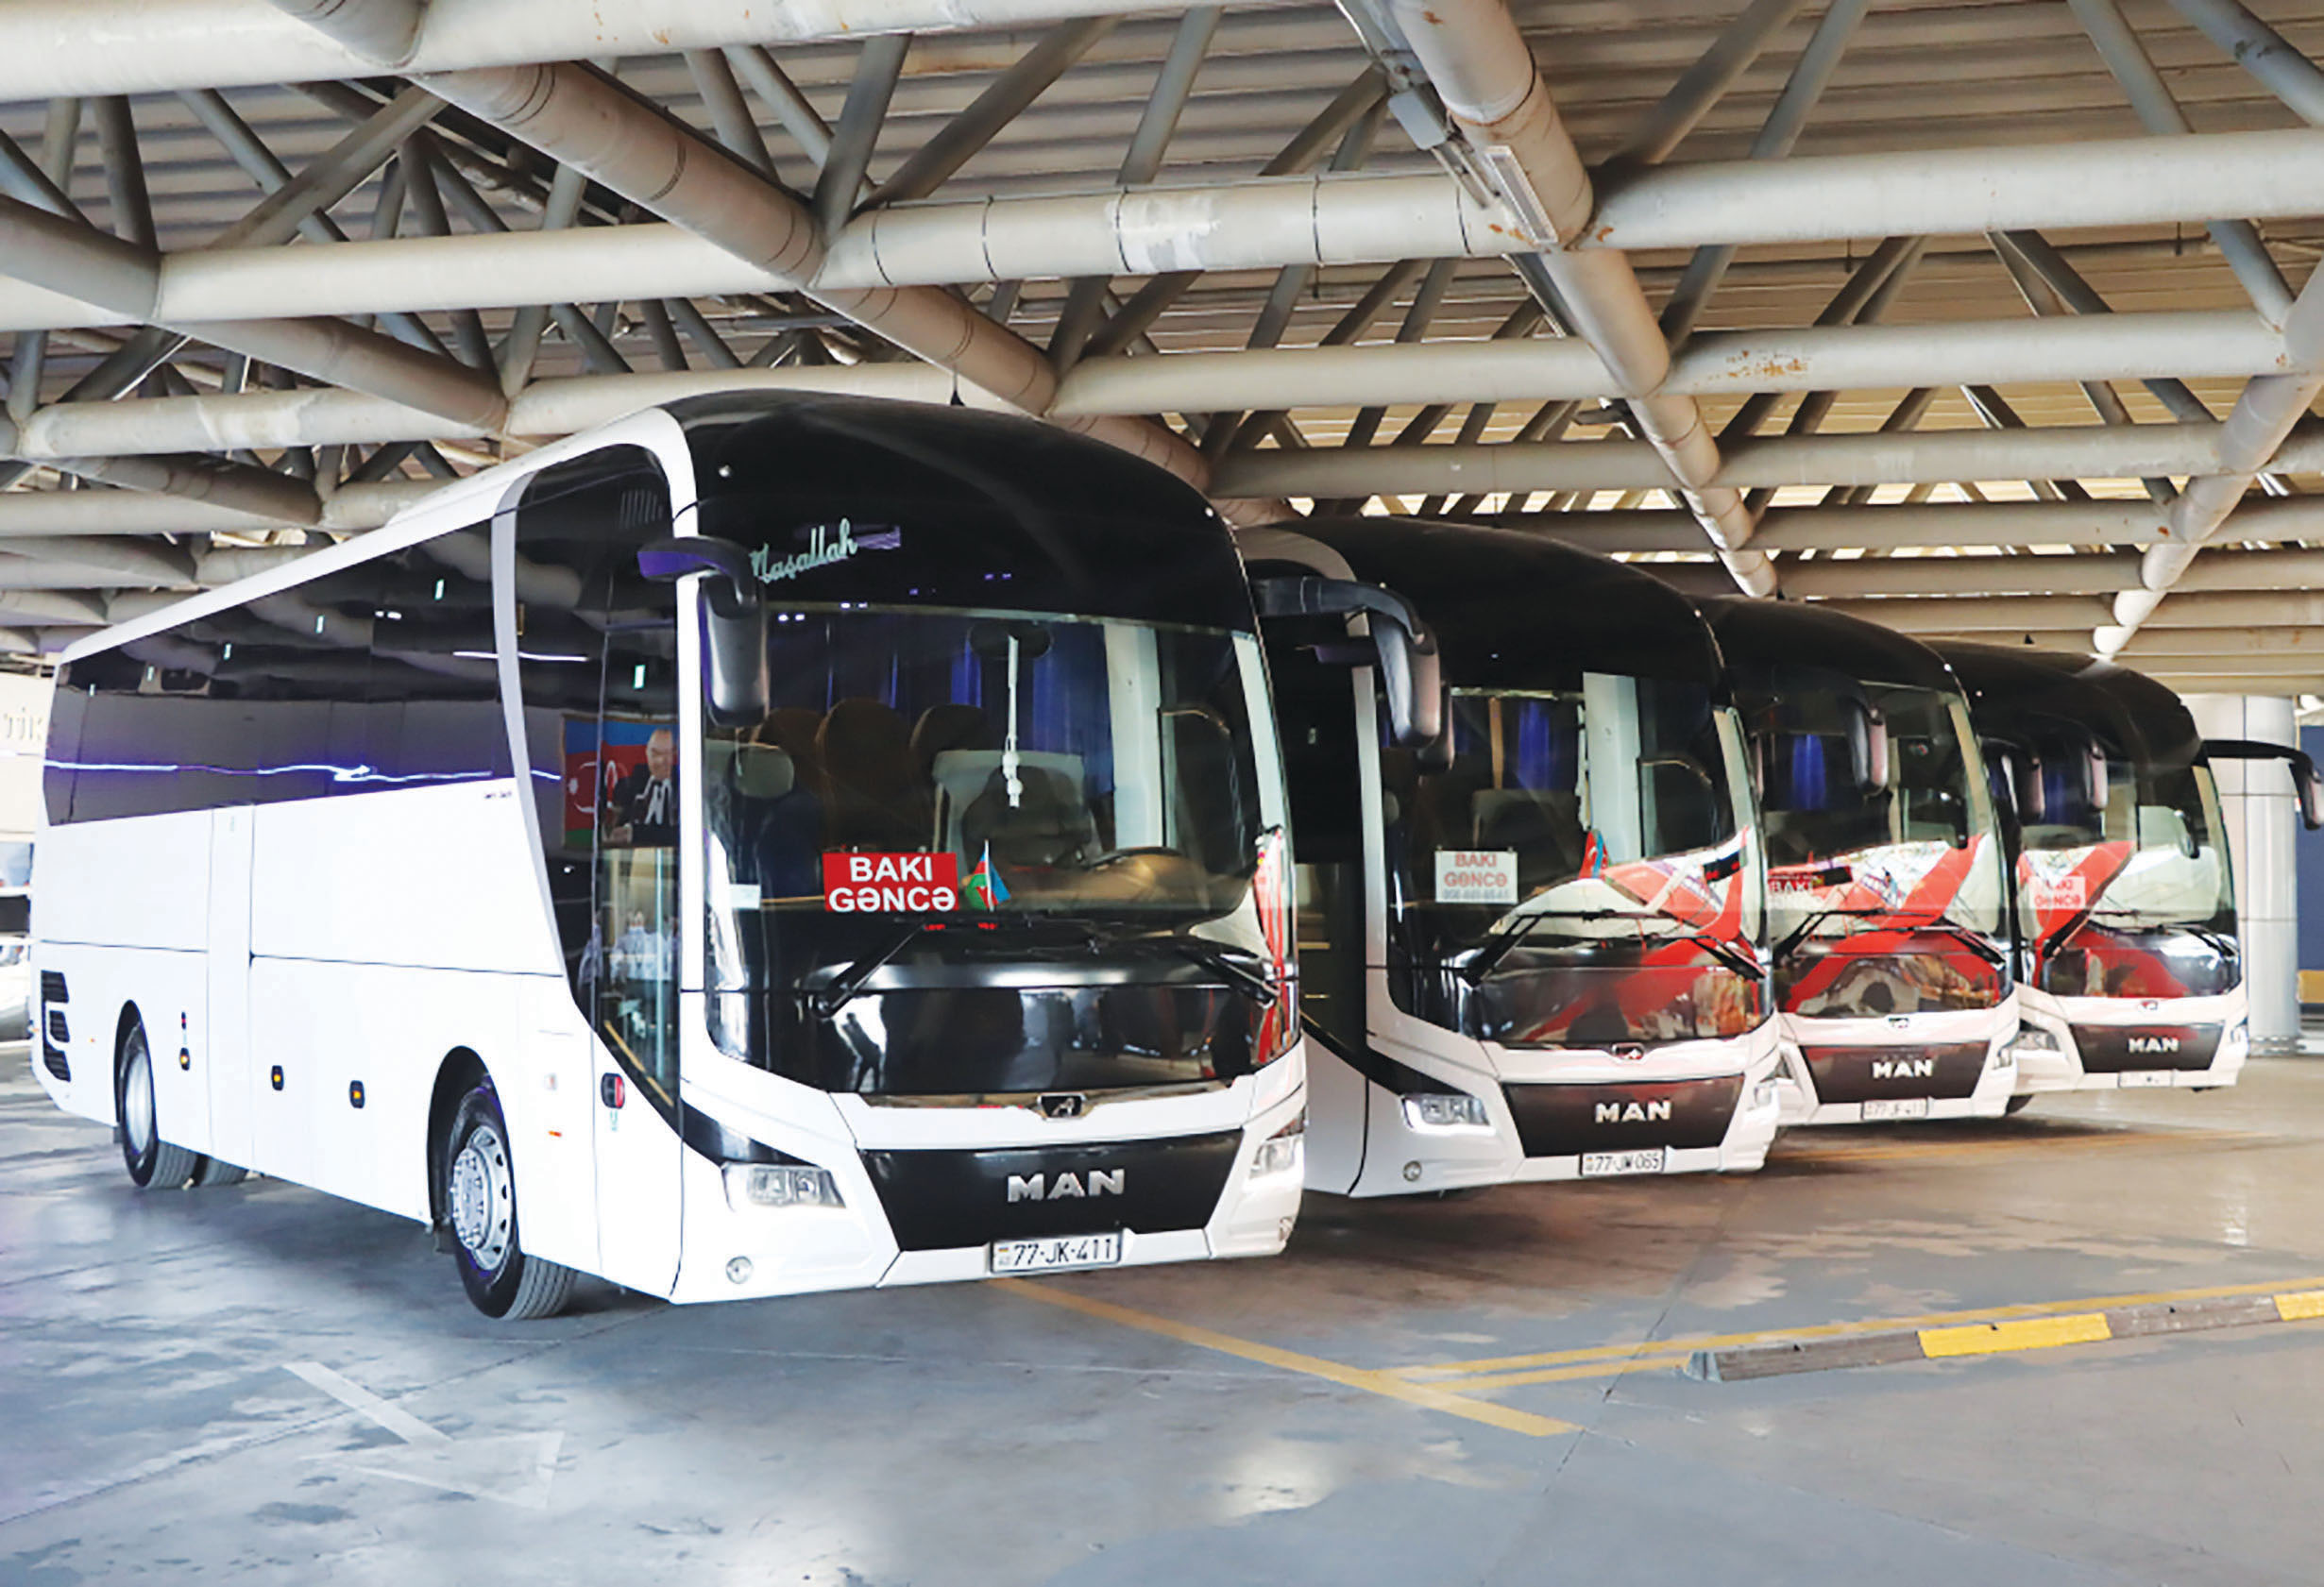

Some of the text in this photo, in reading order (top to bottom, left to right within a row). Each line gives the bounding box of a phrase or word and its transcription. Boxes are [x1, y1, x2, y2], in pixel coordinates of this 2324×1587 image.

[850, 856, 933, 882] BAKI
[1455, 853, 1497, 868] BAKI
[828, 886, 956, 913] GƏNCƏ
[2129, 1037, 2179, 1053] MAN
[1873, 1058, 1933, 1078] MAN
[1595, 1100, 1671, 1123] MAN
[1008, 1169, 1125, 1203] MAN
